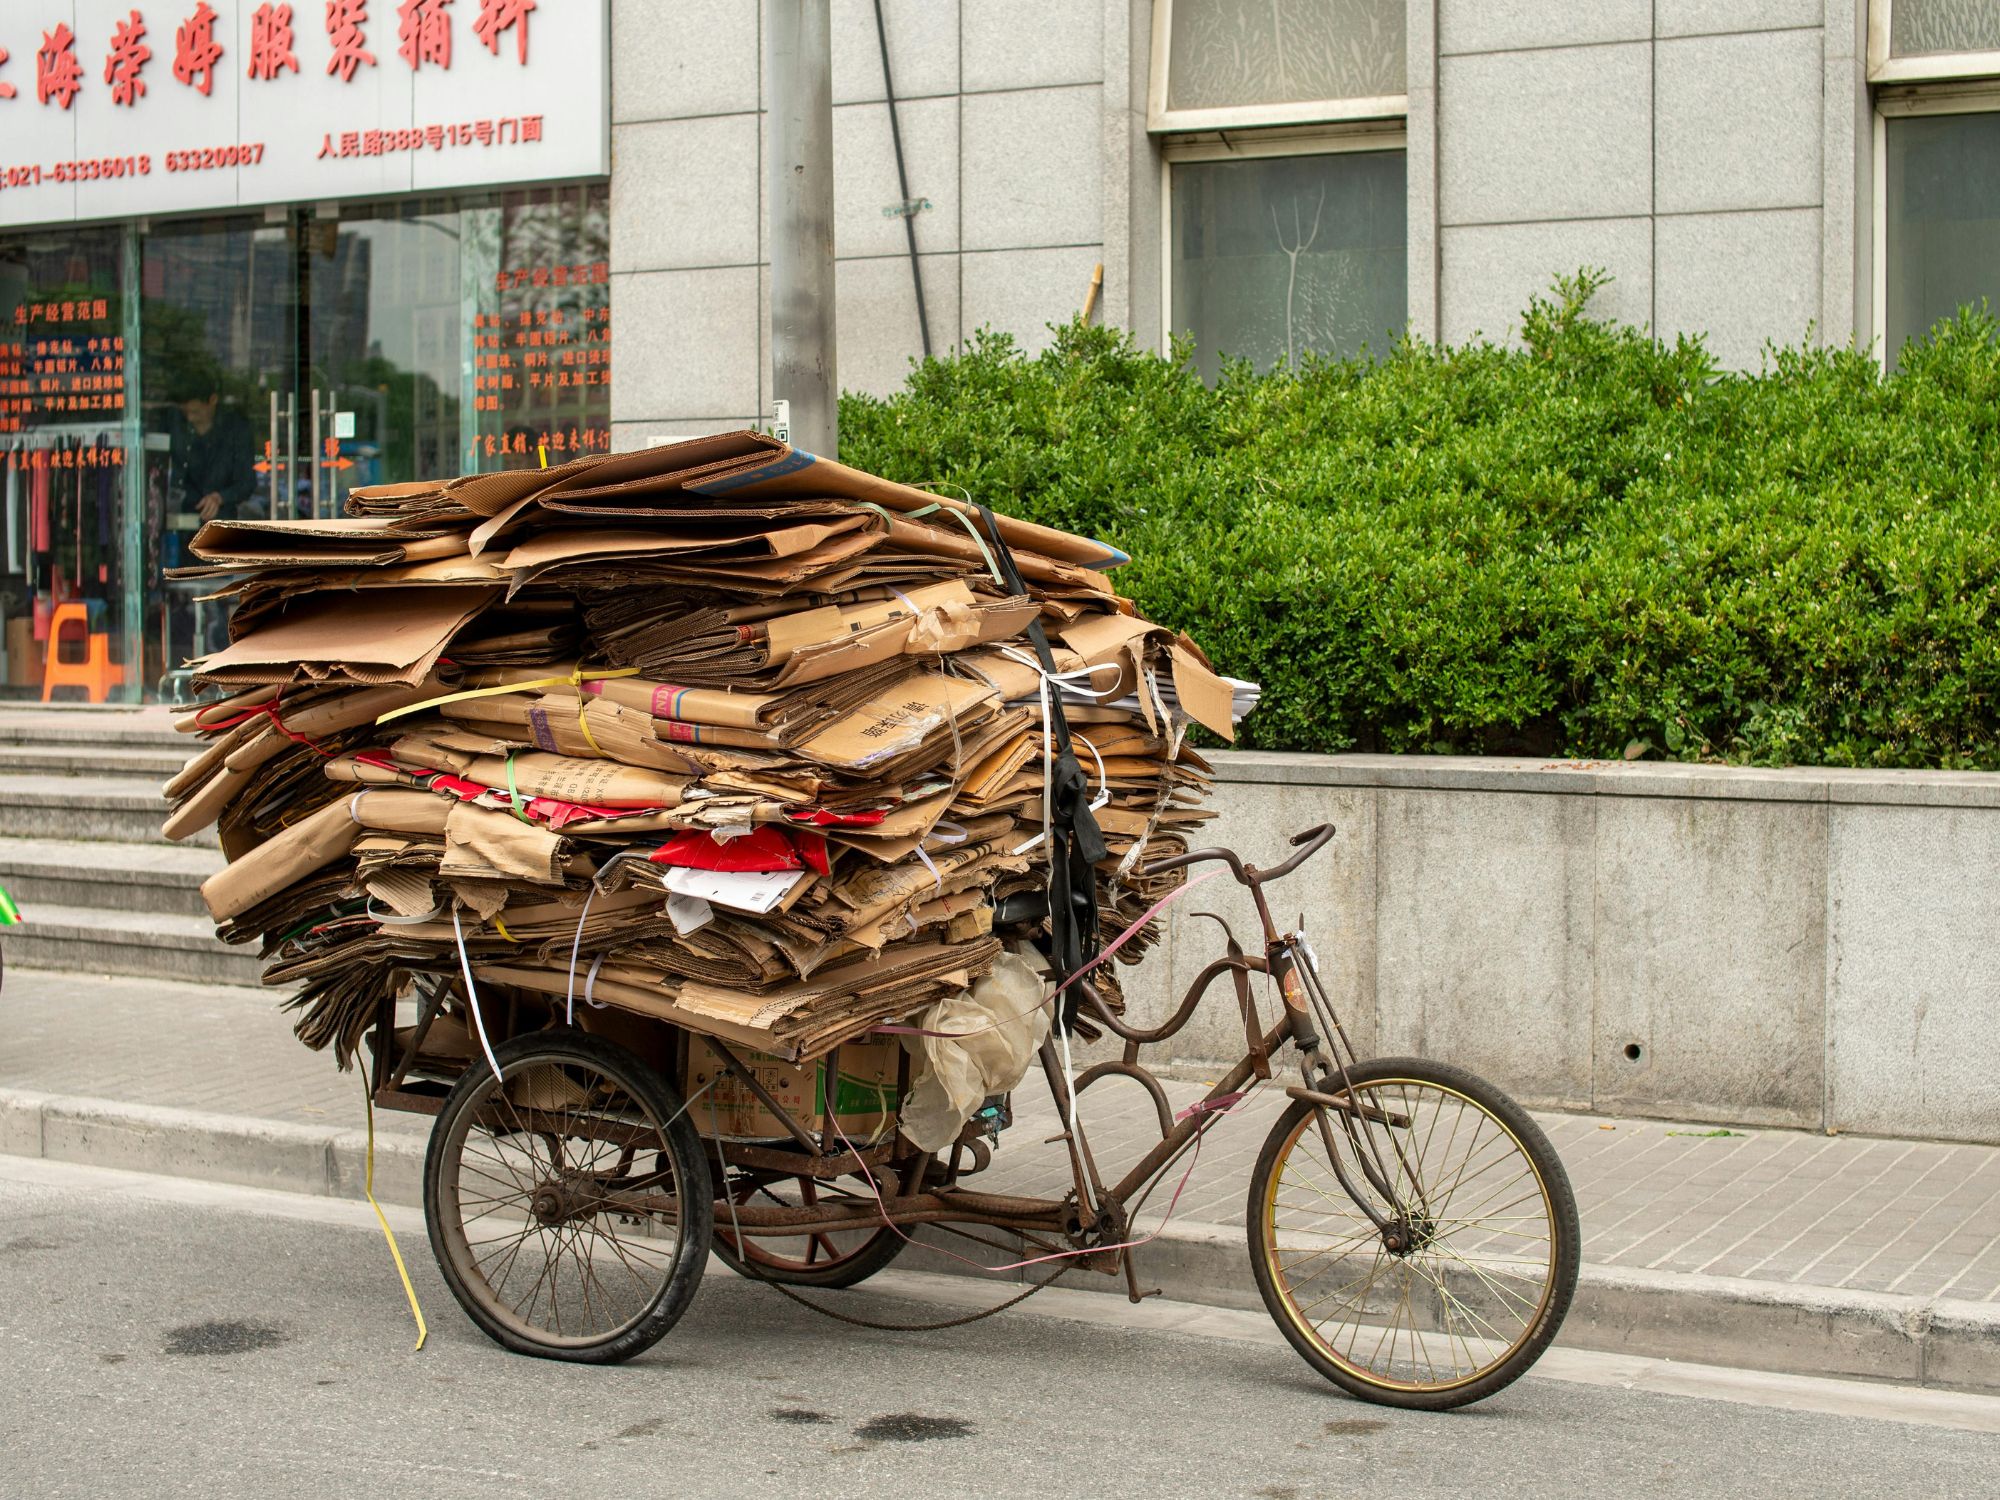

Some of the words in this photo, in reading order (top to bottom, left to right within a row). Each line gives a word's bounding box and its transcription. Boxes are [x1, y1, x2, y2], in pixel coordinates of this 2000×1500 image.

[318, 114, 543, 159] 人民路388号15号门面
[0, 155, 151, 191] :021-63336018
[165, 143, 264, 172] 63320987
[496, 262, 609, 291] 生产经营范围
[15, 299, 108, 324] 生产经营范围
